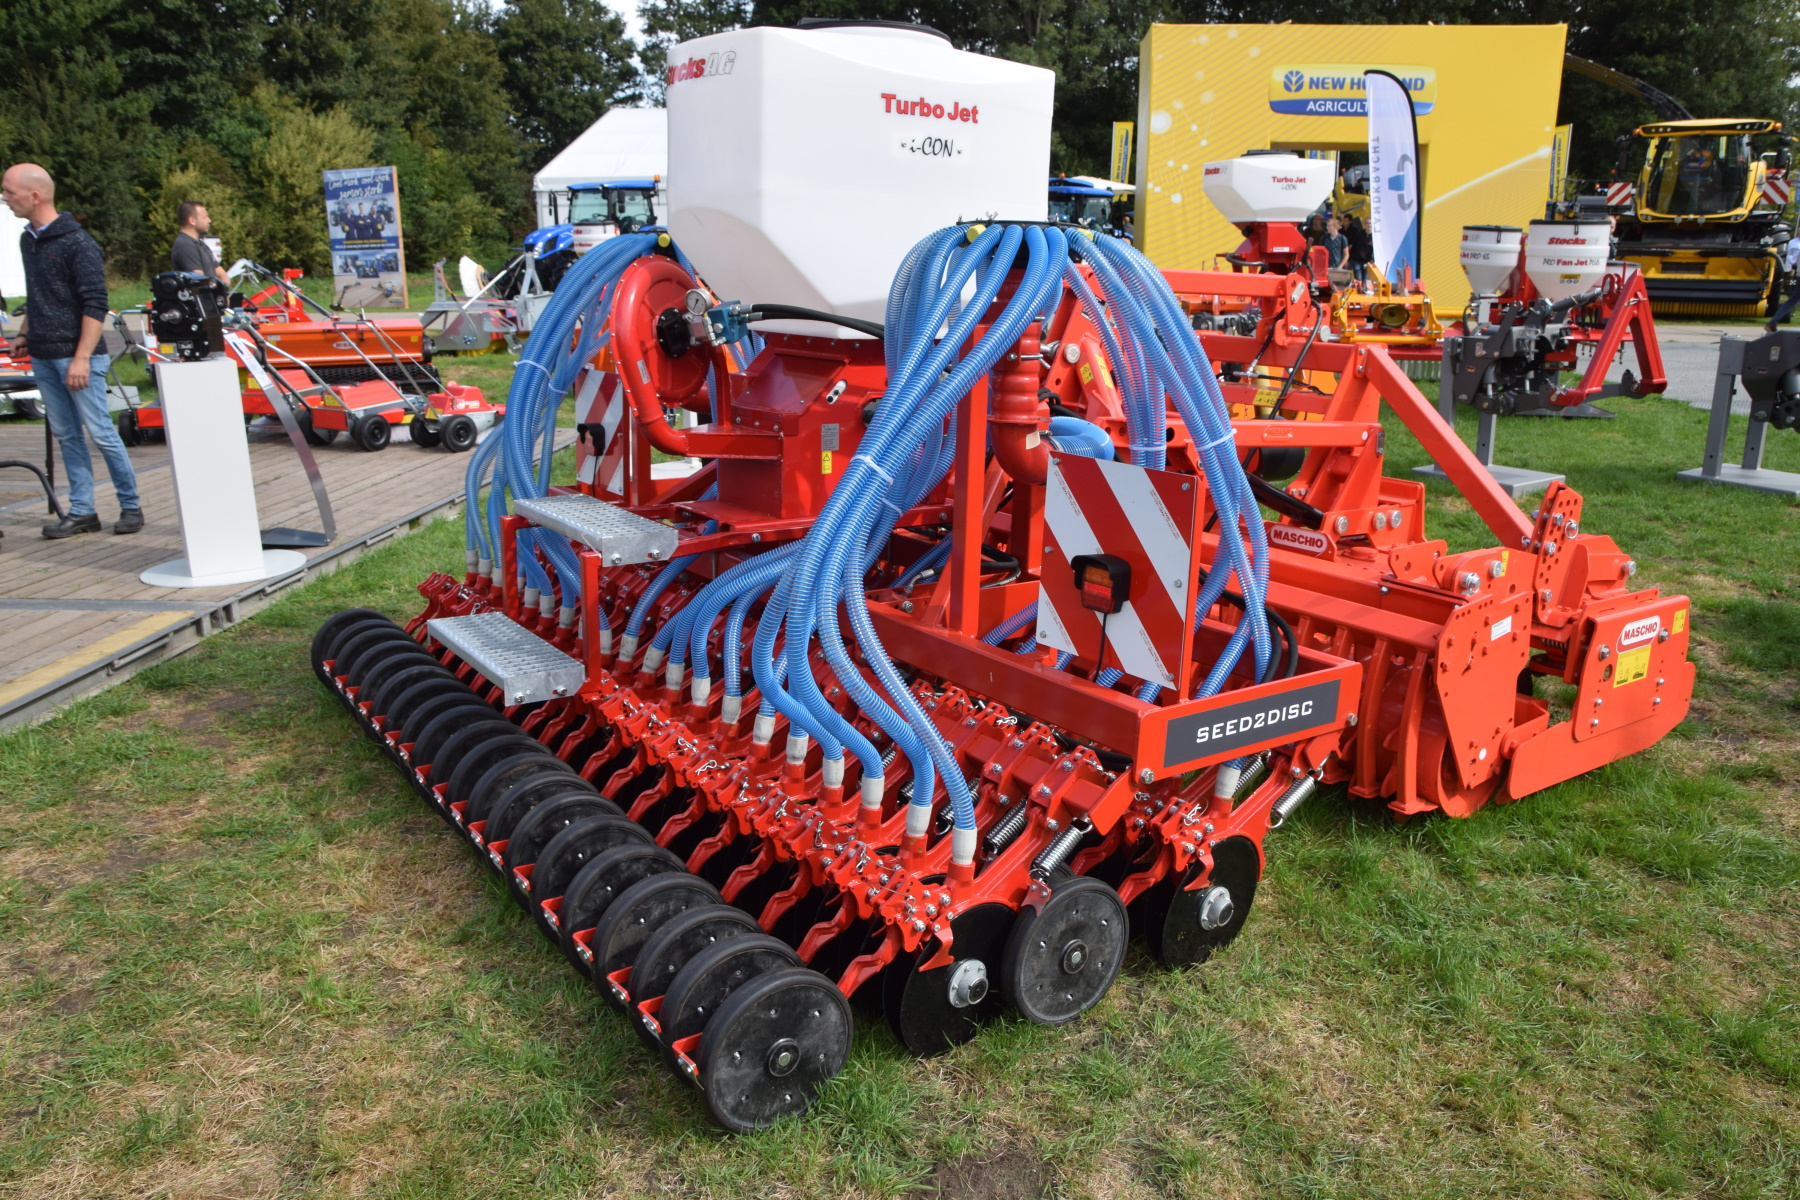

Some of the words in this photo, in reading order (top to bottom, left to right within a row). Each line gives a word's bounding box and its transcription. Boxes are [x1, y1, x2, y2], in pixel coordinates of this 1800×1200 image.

[1308, 76, 1347, 90] NEW
[881, 93, 945, 119] Turbo
[947, 101, 979, 124] Jet
[1306, 100, 1369, 113] AGRICULT
[1556, 258, 1573, 266] Fan
[1574, 258, 1588, 266] Jet
[1273, 529, 1324, 549] MASCHIO
[1623, 621, 1658, 641] MASCHIO
[1196, 700, 1314, 743] SEED2DISC
